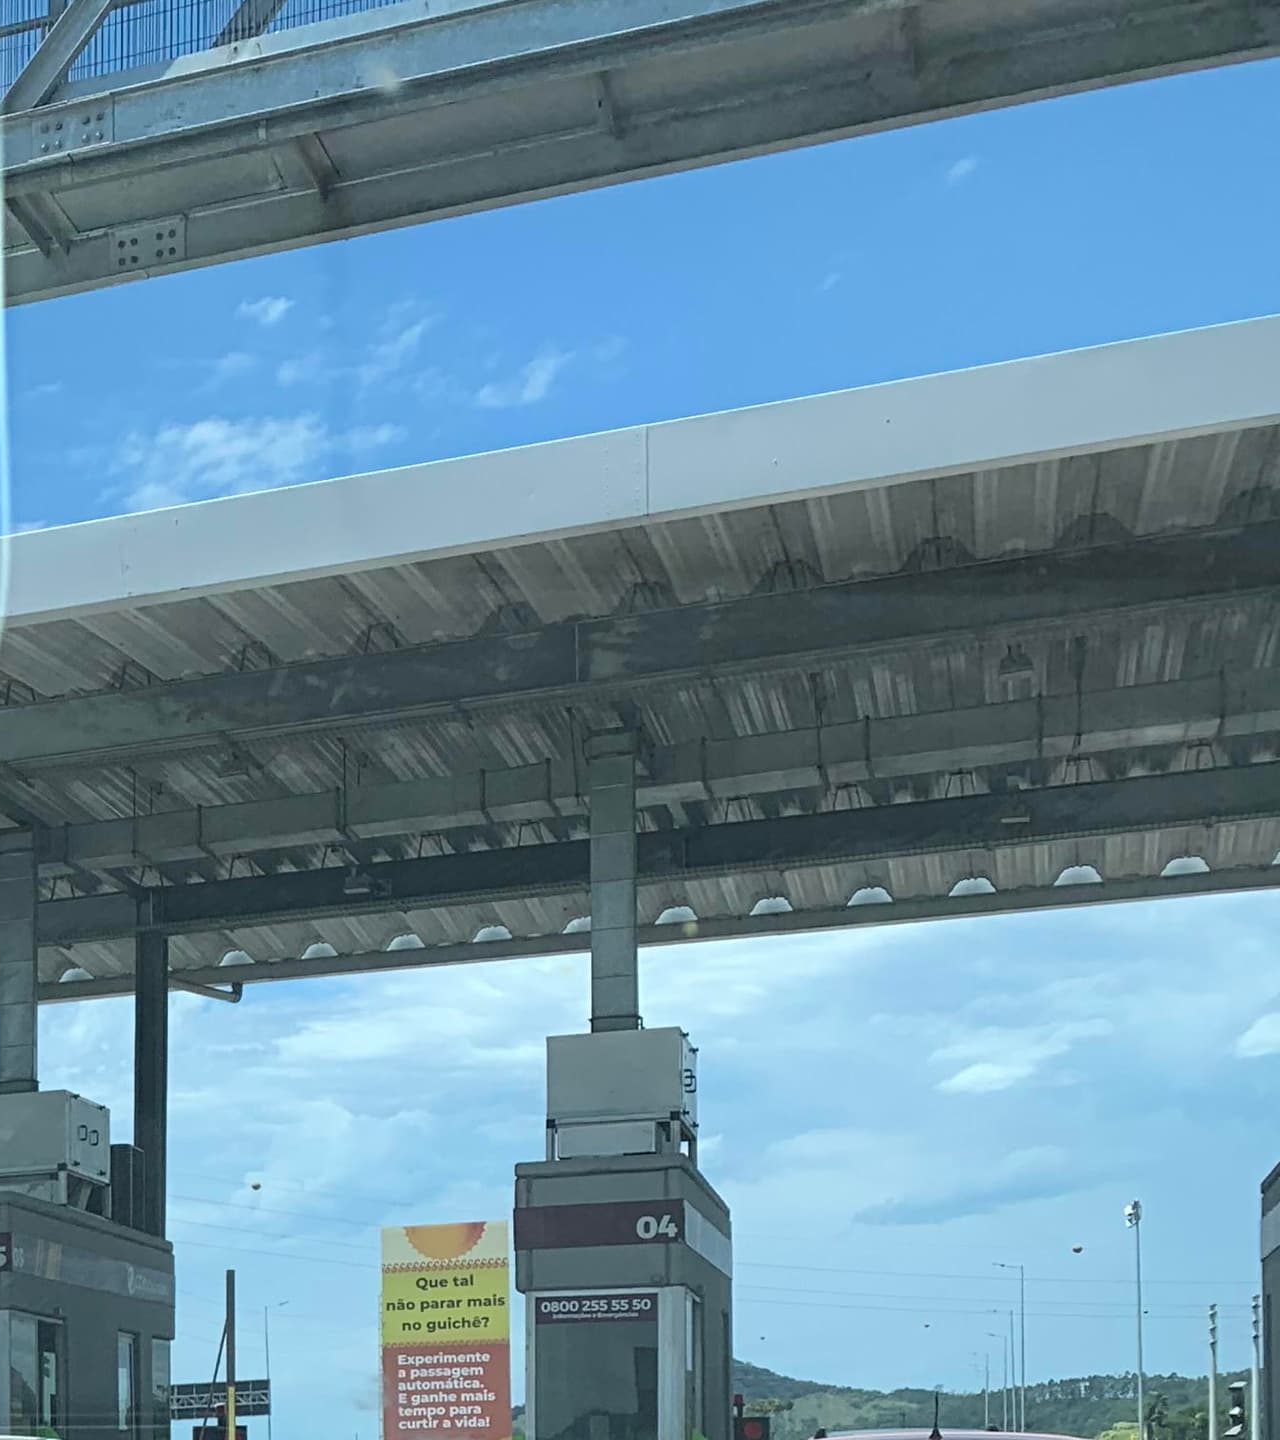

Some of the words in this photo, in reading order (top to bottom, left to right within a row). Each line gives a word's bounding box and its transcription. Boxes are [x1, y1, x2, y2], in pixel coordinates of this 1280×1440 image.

[636, 1215, 678, 1239] 04
[415, 1277, 449, 1291] Que
[453, 1274, 474, 1287] tal
[386, 1299, 415, 1311] não
[420, 1300, 462, 1312] parar
[467, 1294, 506, 1307] mais
[541, 1301, 579, 1312] 0800
[582, 1300, 608, 1311] 255
[611, 1299, 629, 1311] 55
[631, 1299, 651, 1310] 50
[402, 1321, 422, 1331] no
[426, 1316, 490, 1333] guichê?
[397, 1352, 491, 1366] Experimente
[398, 1370, 406, 1378] a
[410, 1367, 484, 1379] passagem
[398, 1378, 485, 1391] automática.
[398, 1393, 407, 1404] E
[411, 1392, 457, 1405] ganhe
[461, 1389, 496, 1402] mais
[398, 1407, 446, 1419] tempo
[449, 1405, 482, 1417] para
[398, 1417, 439, 1429] curtir
[442, 1420, 451, 1428] a
[455, 1416, 490, 1428] vida!
